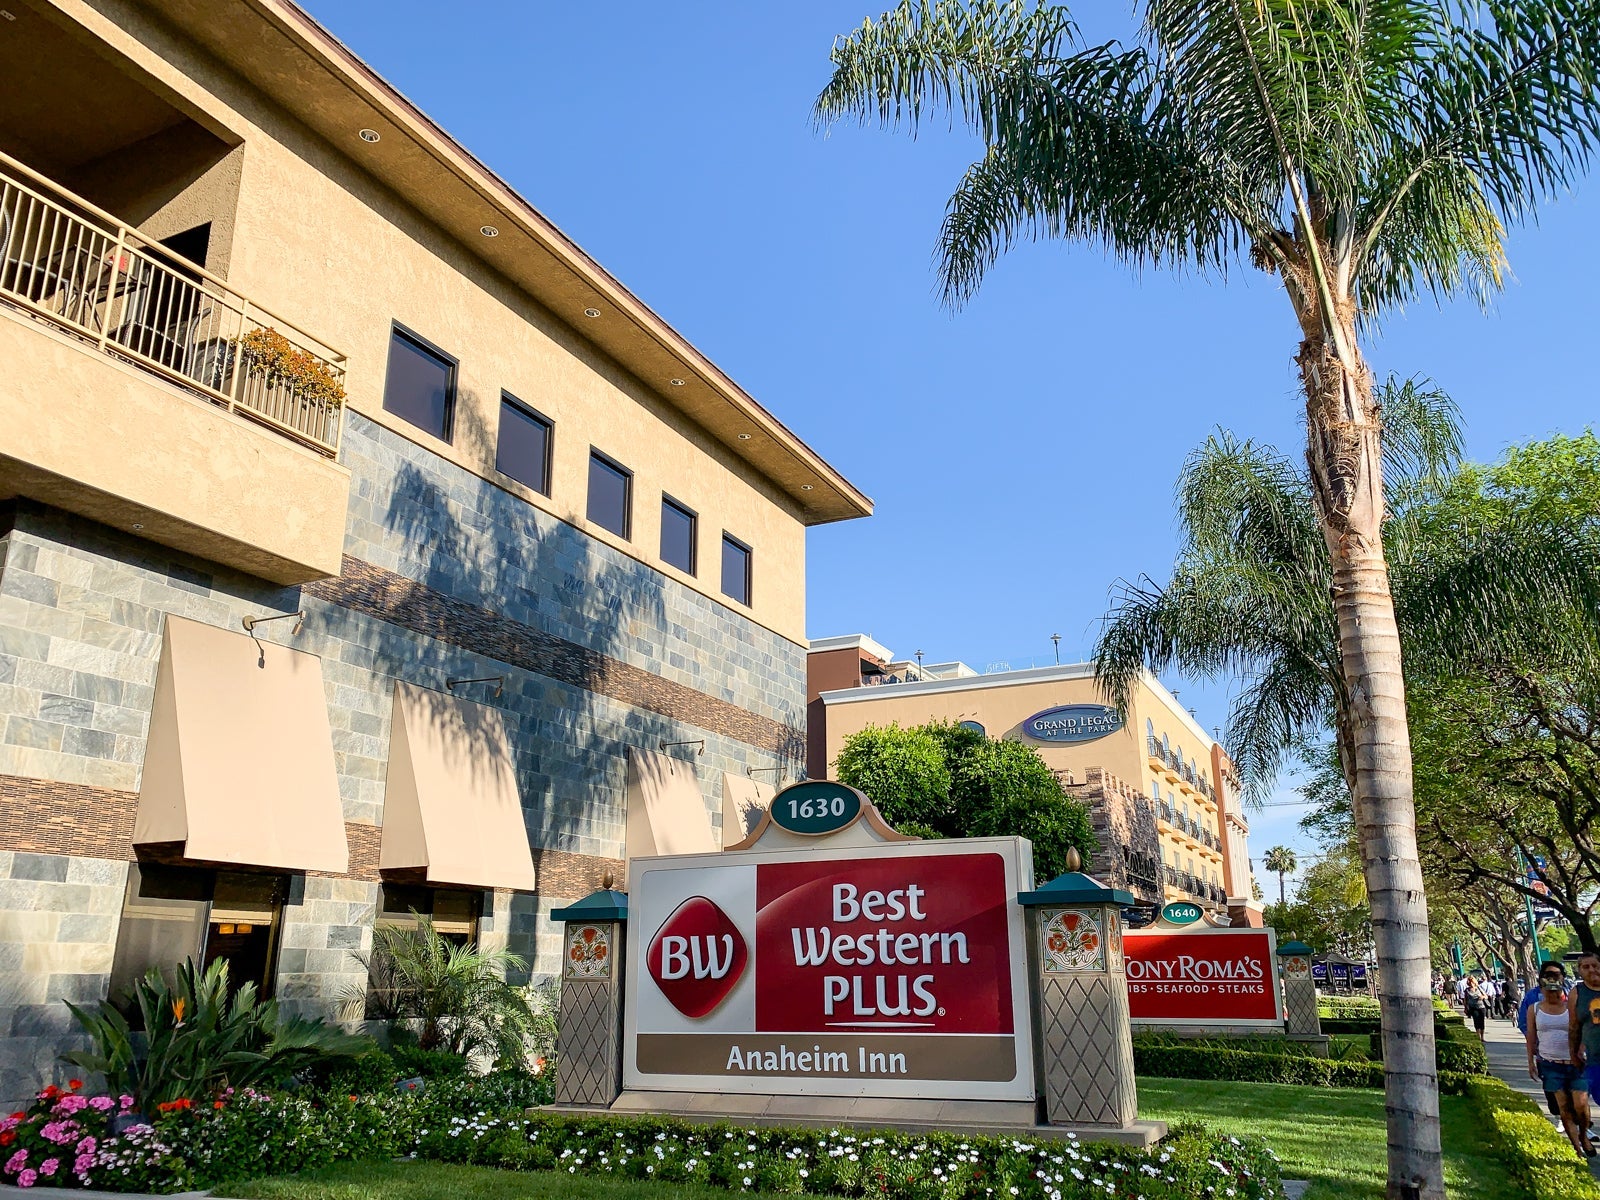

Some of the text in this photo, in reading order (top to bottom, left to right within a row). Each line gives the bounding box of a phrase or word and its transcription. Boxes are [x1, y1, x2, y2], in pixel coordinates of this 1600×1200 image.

[1034, 717, 1077, 731] GRAND
[1063, 727, 1083, 735] THE
[1088, 724, 1114, 733] PARK
[788, 797, 846, 819] 1630
[832, 883, 927, 922] Best
[1169, 908, 1196, 918] 1640
[661, 934, 734, 980] BW
[791, 926, 971, 967] Western
[1178, 955, 1264, 982] ROMA'S
[1128, 984, 1265, 994] IBS SEAFOOD STEAKS
[726, 1044, 908, 1074] Anaheim Inn
